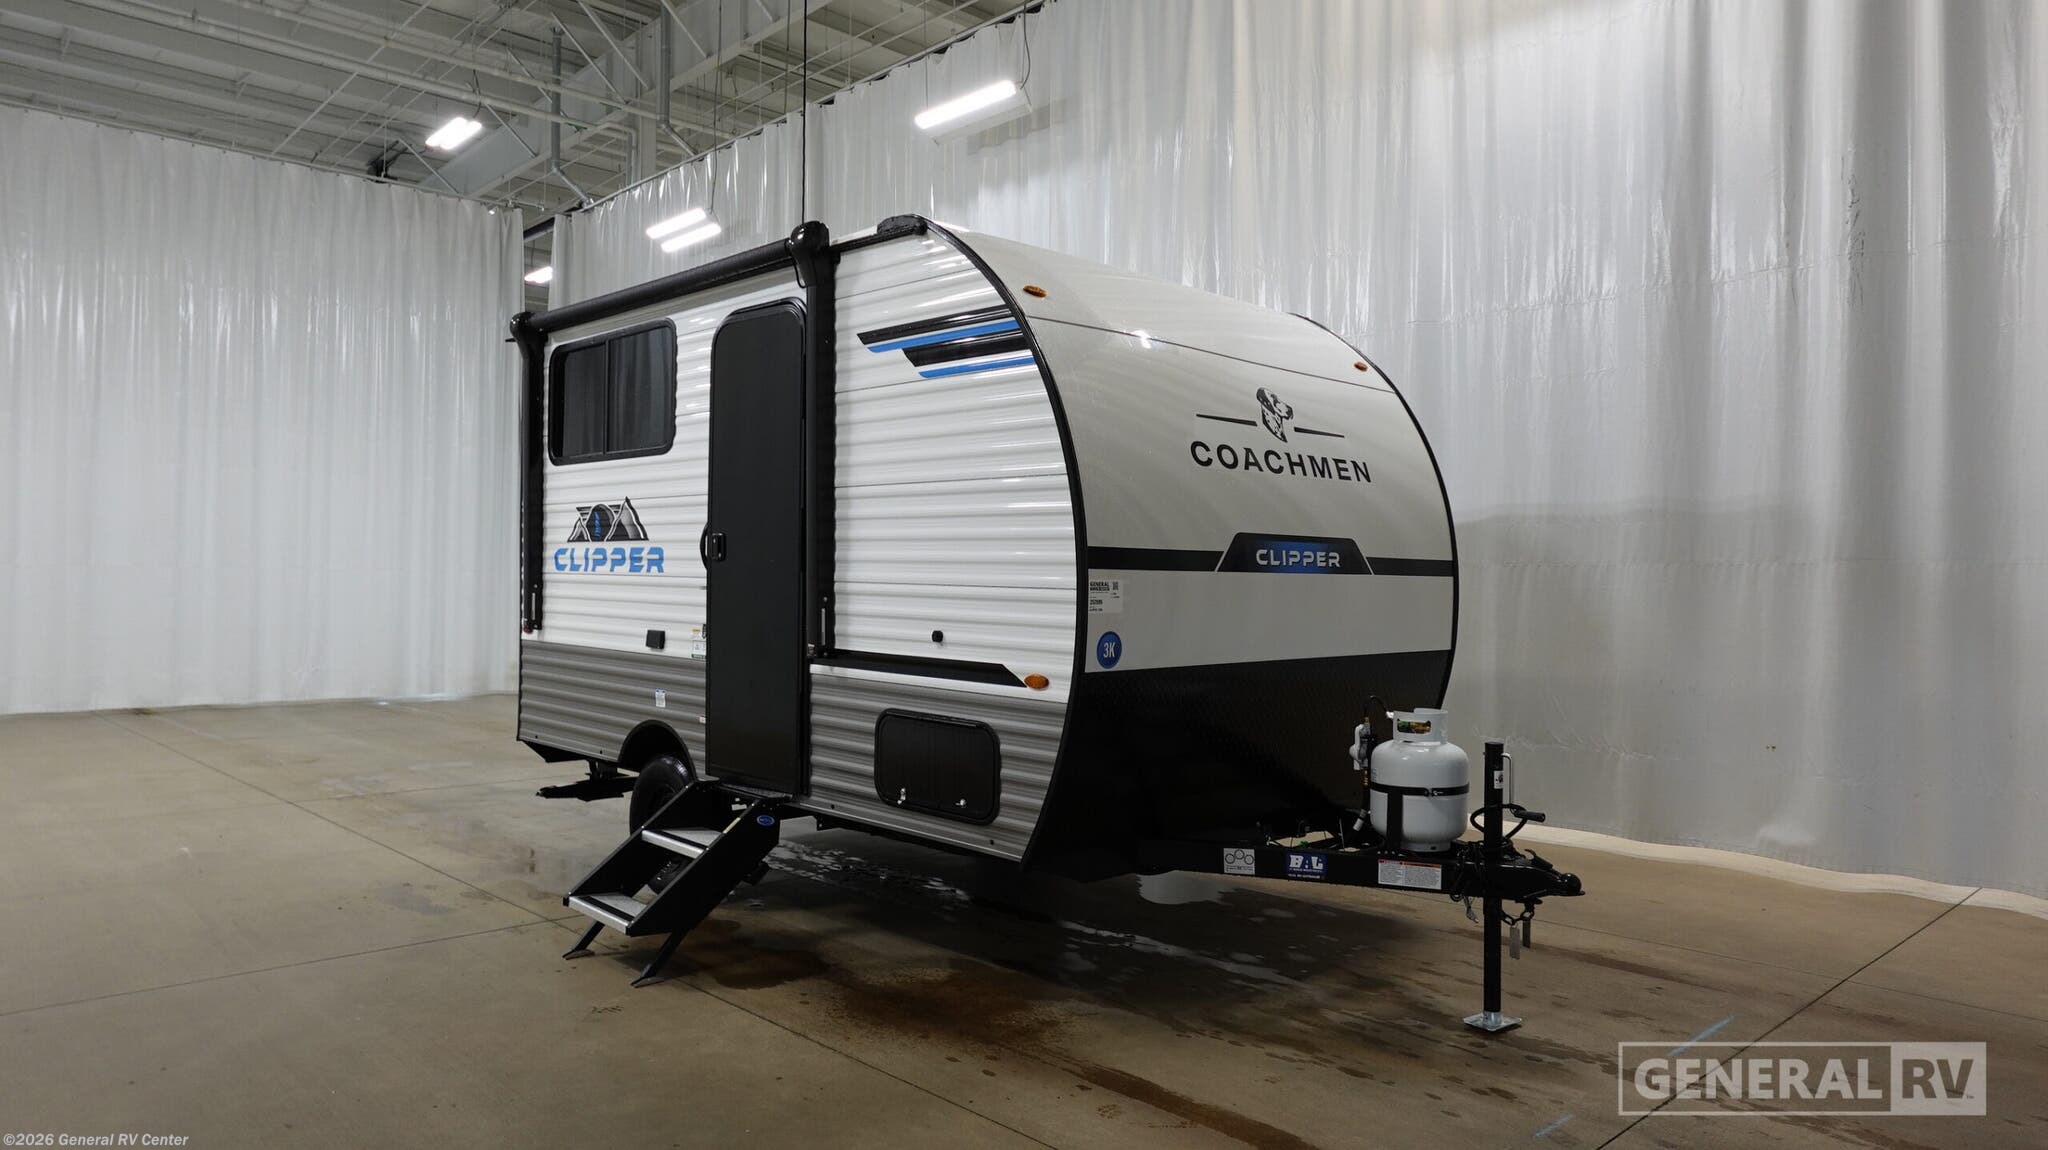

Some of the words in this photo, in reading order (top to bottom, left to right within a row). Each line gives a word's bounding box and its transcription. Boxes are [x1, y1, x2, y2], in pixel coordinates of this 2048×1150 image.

[1190, 440, 1371, 483] COACHMEN
[554, 547, 665, 573] CLIPPER
[1255, 549, 1341, 567] CLIPPER
[1103, 642, 1115, 658] 3K
